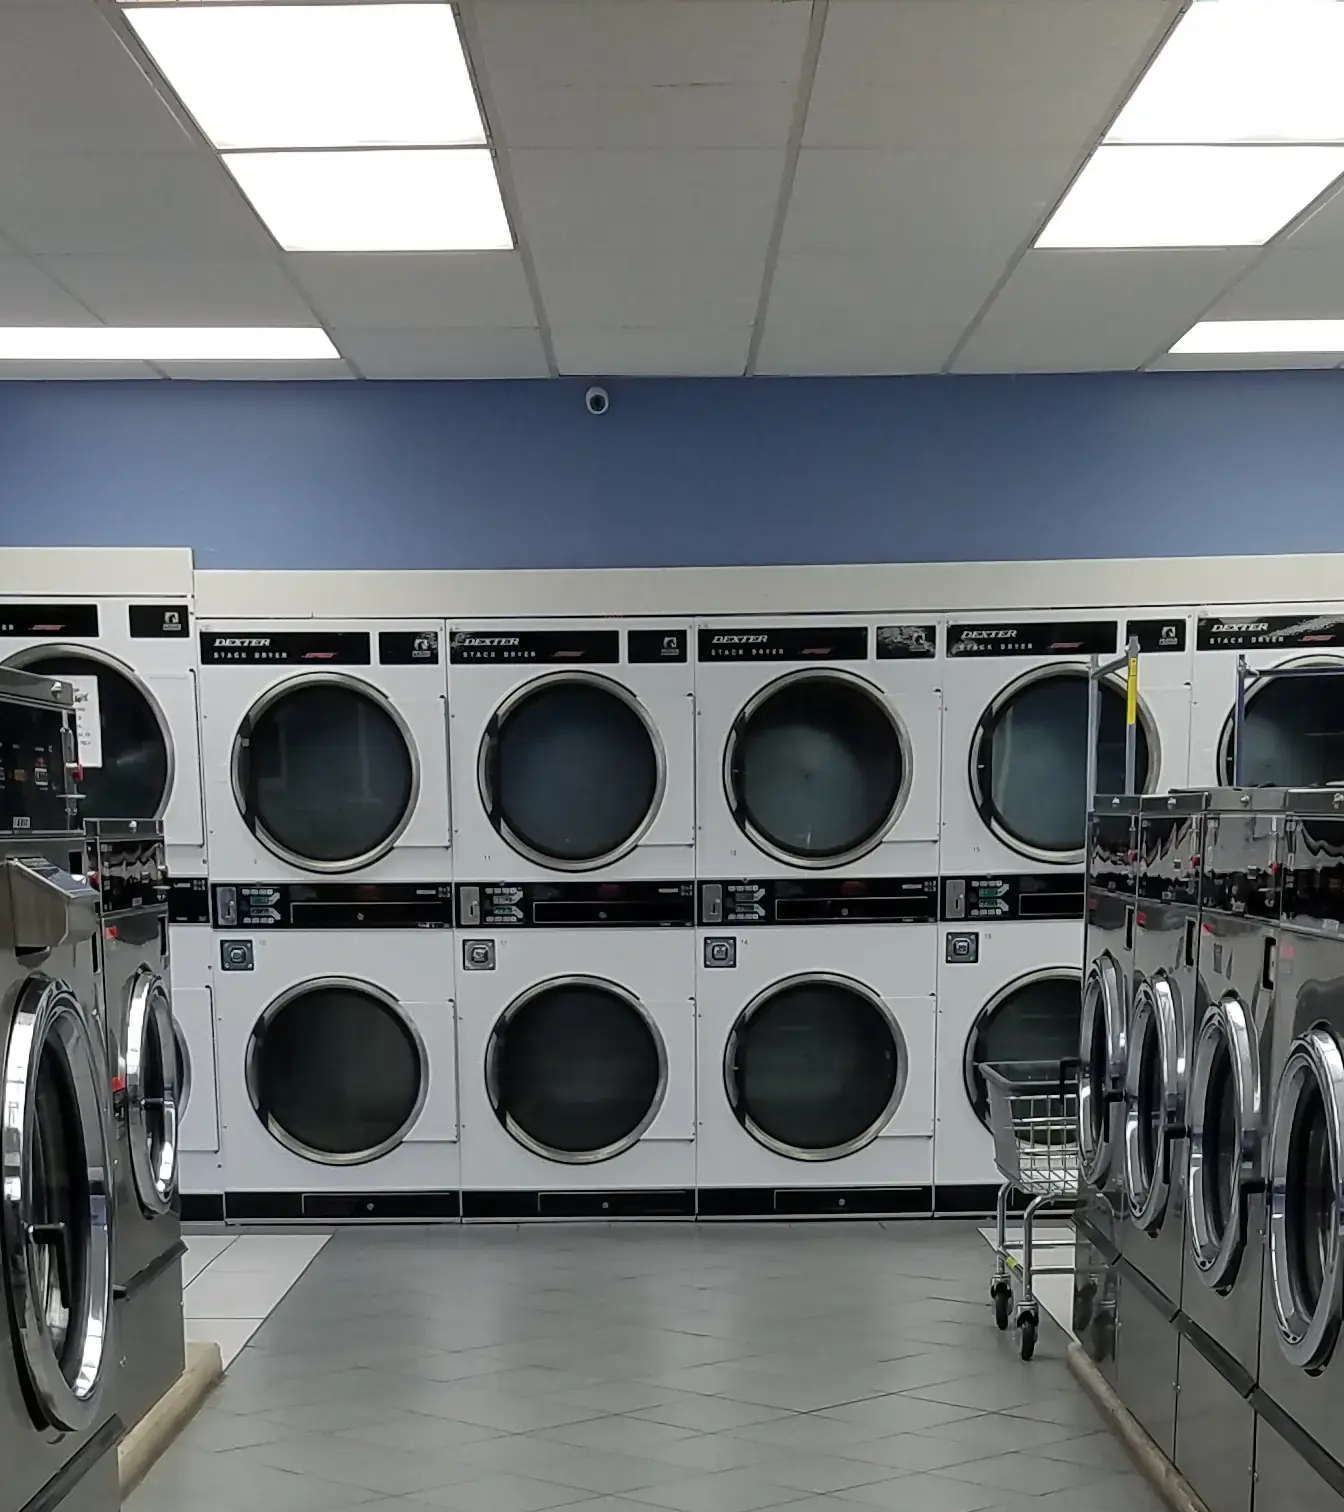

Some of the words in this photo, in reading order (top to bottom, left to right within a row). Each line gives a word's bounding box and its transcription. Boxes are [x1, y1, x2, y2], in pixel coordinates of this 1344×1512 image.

[1211, 622, 1269, 632] DEXTER
[961, 629, 1017, 638] DEXTER
[213, 638, 271, 647] DEXTER
[464, 638, 520, 646] DEXTER
[712, 634, 768, 643] DEXTER
